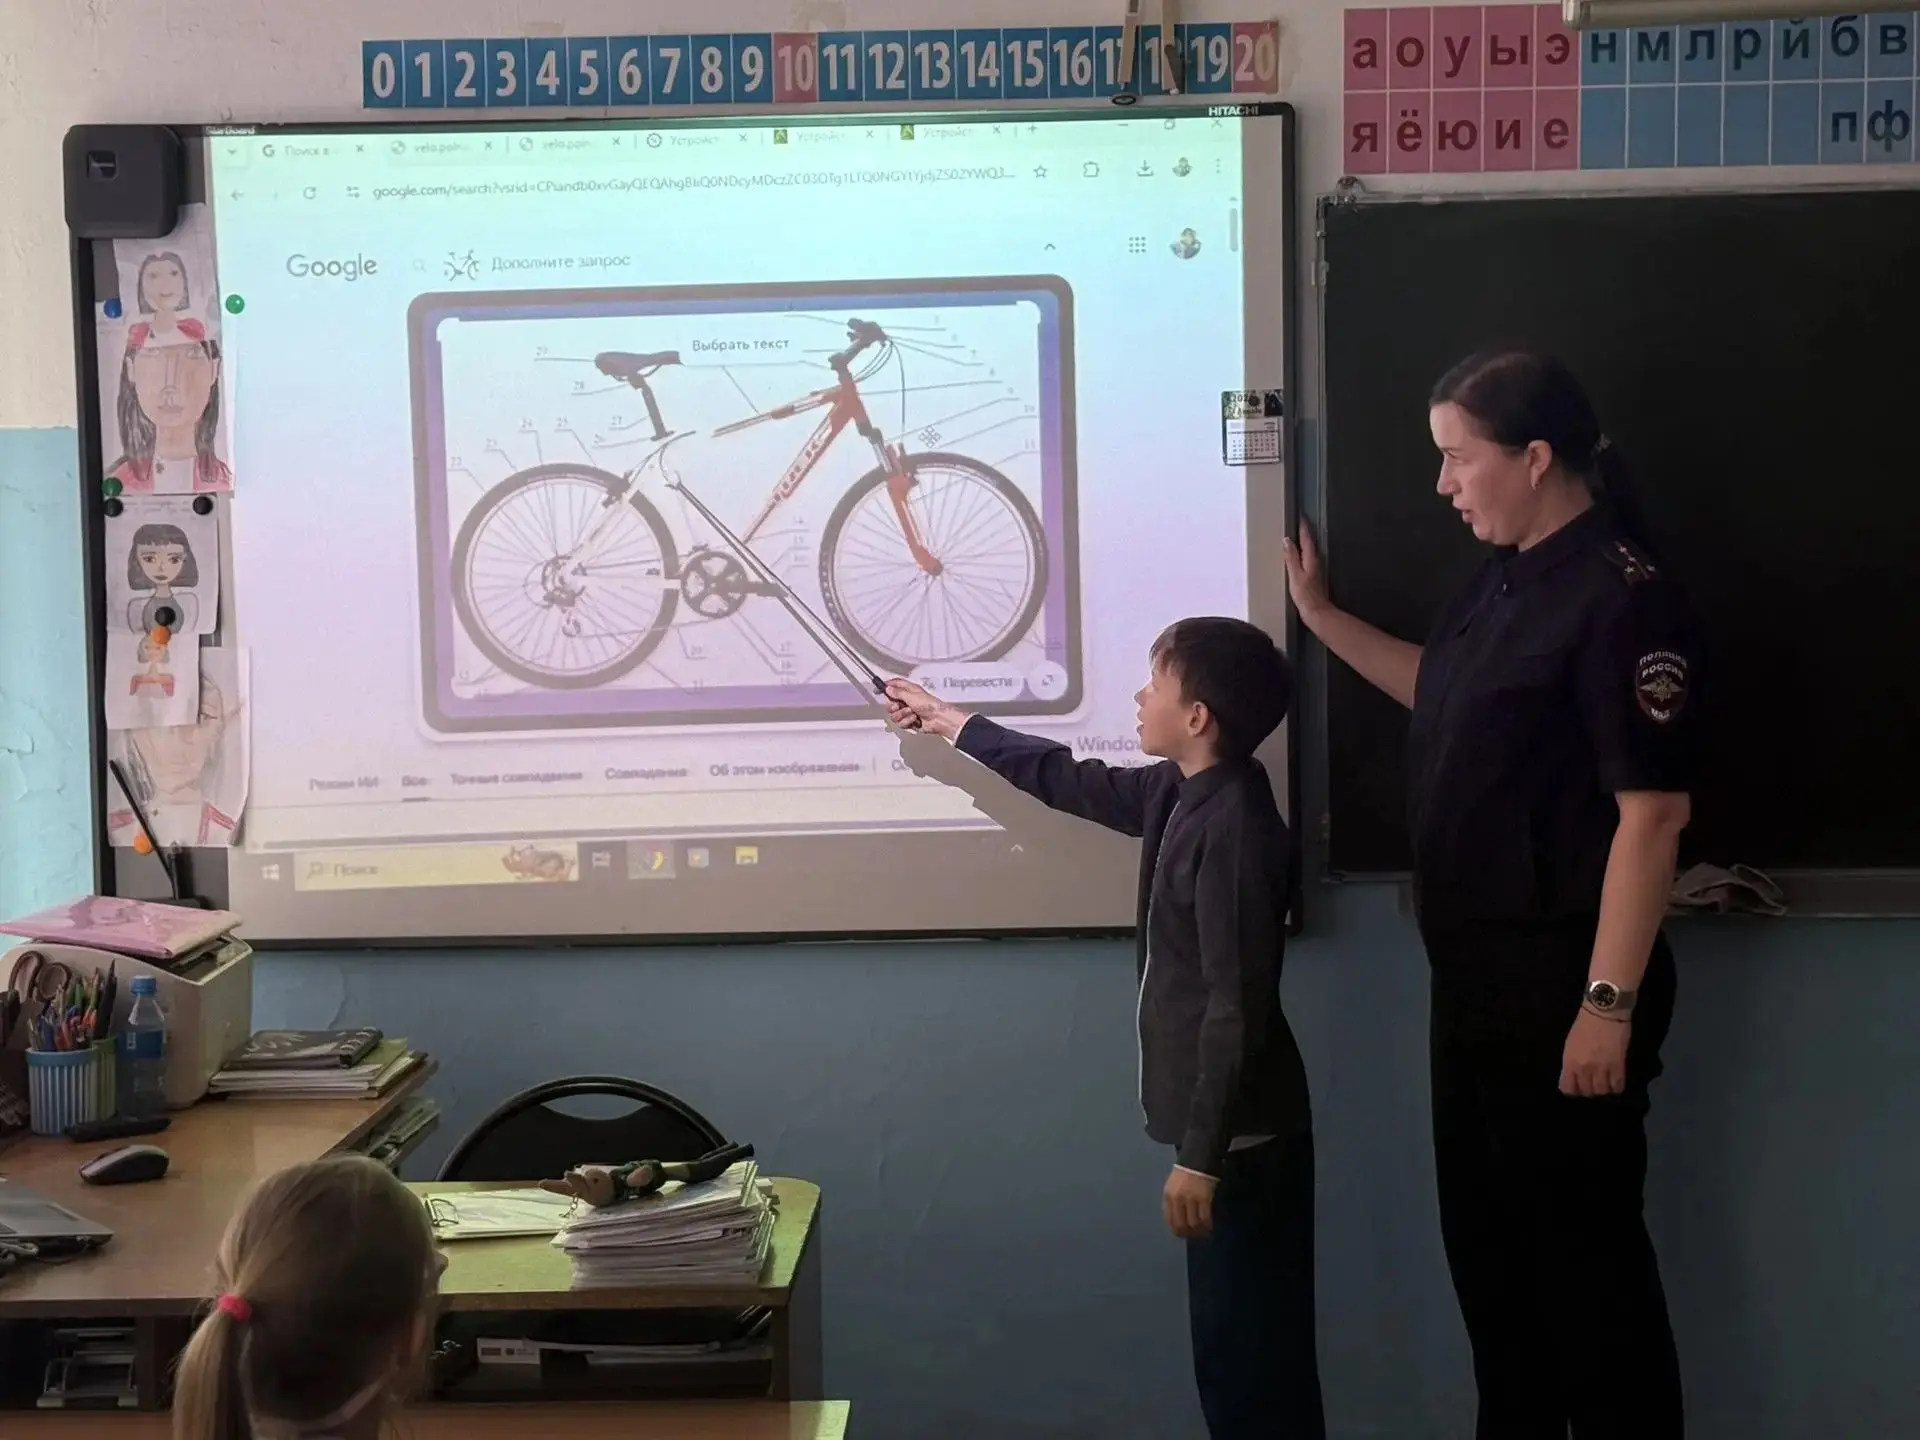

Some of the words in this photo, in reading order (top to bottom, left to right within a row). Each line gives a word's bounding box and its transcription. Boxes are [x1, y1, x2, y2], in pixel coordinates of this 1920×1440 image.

[373, 53, 394, 97] 0
[415, 52, 430, 97] 1
[455, 52, 476, 97] 2
[496, 51, 516, 96] 3
[536, 51, 559, 95] 4
[579, 50, 598, 95] 5
[619, 49, 641, 94] 6
[660, 48, 680, 93] 7
[701, 47, 723, 92] 8
[742, 46, 763, 92] 9
[778, 46, 814, 91] 10
[823, 44, 856, 90] 11
[869, 43, 905, 89] 12
[915, 42, 950, 88] 13
[961, 41, 999, 87] 14
[1007, 40, 1044, 87] 15
[1053, 39, 1091, 85] 16
[1100, 38, 1126, 85] 1
[1145, 36, 1182, 84] 1
[1191, 35, 1228, 82] 19
[1236, 34, 1275, 81] 20
[1208, 105, 1259, 117] HITACHI
[286, 253, 378, 282] Google
[492, 257, 574, 272] Дополните
[579, 256, 631, 270] запрос
[692, 339, 750, 352] Выбрать
[753, 338, 790, 350] текст
[943, 677, 1013, 691] Перевести
[709, 763, 728, 776] Об
